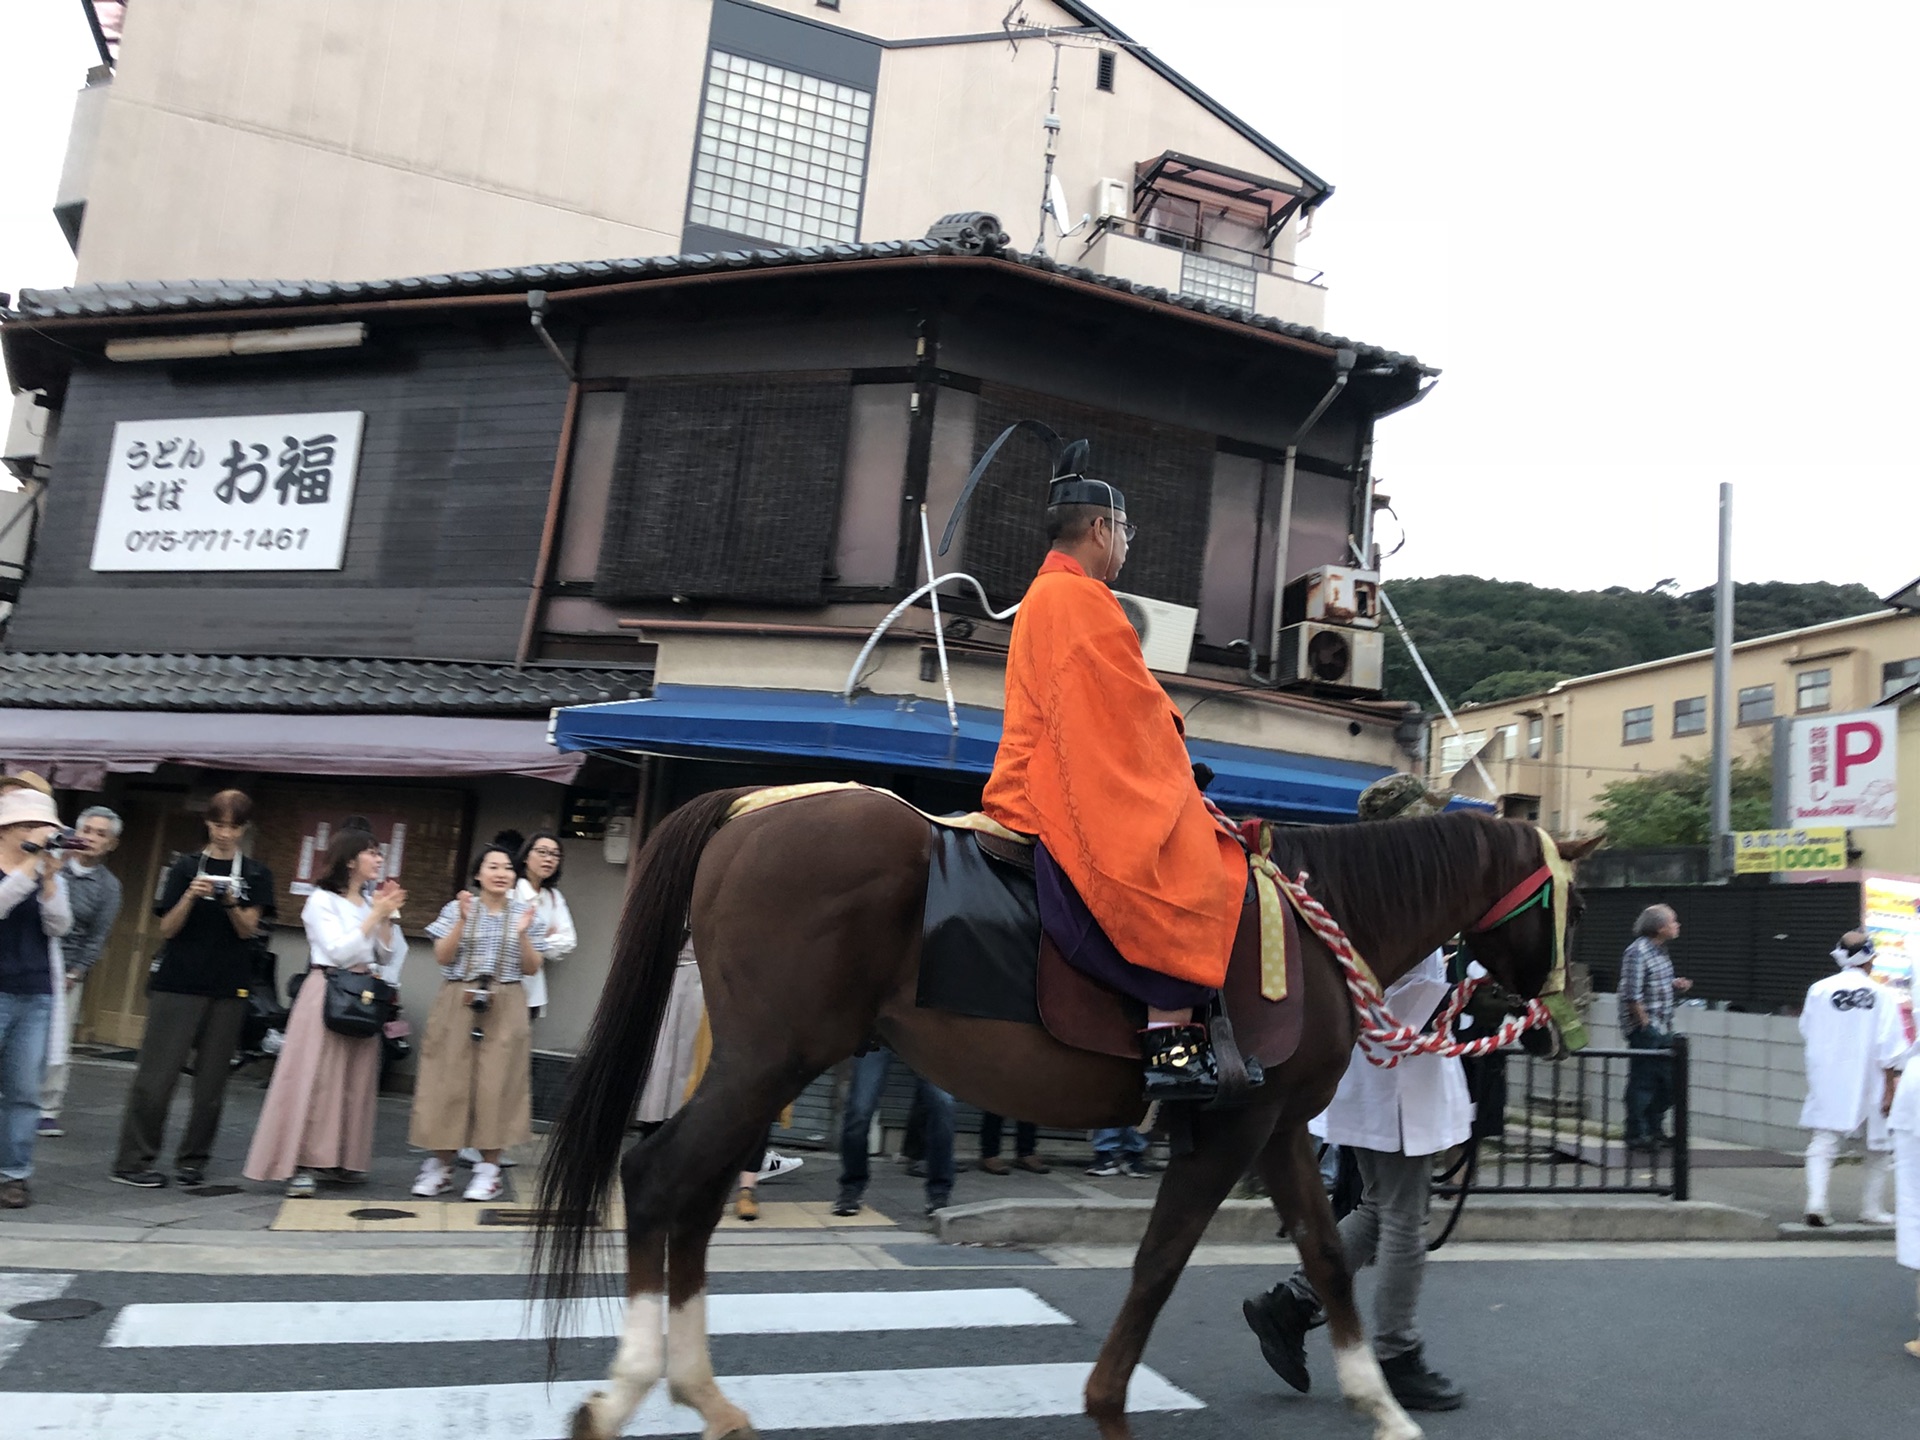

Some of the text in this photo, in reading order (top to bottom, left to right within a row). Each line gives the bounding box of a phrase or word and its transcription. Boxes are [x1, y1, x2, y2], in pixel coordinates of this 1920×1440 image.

[127, 437, 204, 470] うどん
[214, 434, 337, 505] お福
[131, 478, 187, 511] そば
[125, 528, 310, 552] 075-771-1461
[1834, 721, 1883, 787] P
